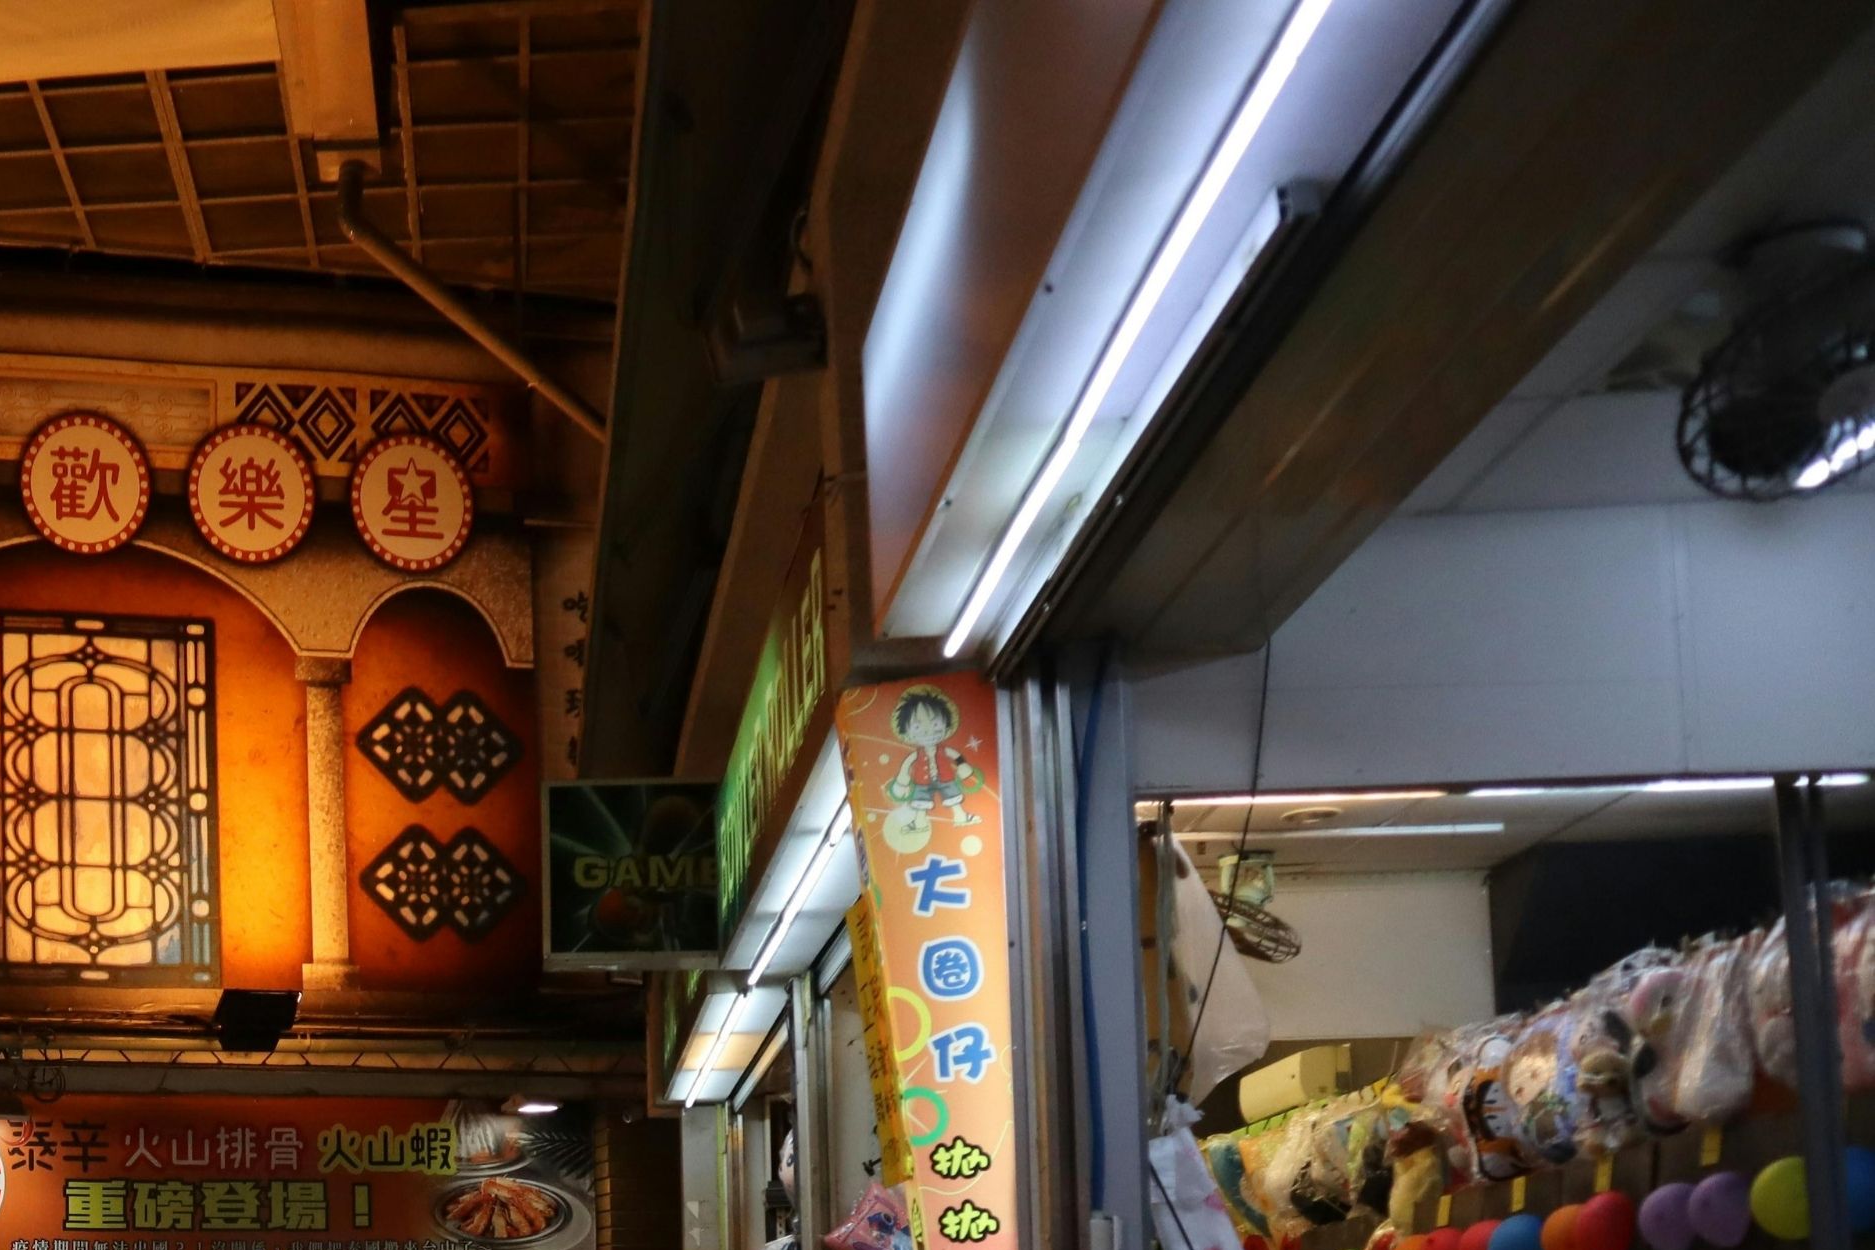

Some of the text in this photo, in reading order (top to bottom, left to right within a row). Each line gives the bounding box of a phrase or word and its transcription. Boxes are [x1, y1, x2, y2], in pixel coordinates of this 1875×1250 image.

[905, 854, 997, 1083] 大圈仔
[125, 1125, 303, 1171] 火山排骨
[322, 1126, 453, 1171] 火山蝦
